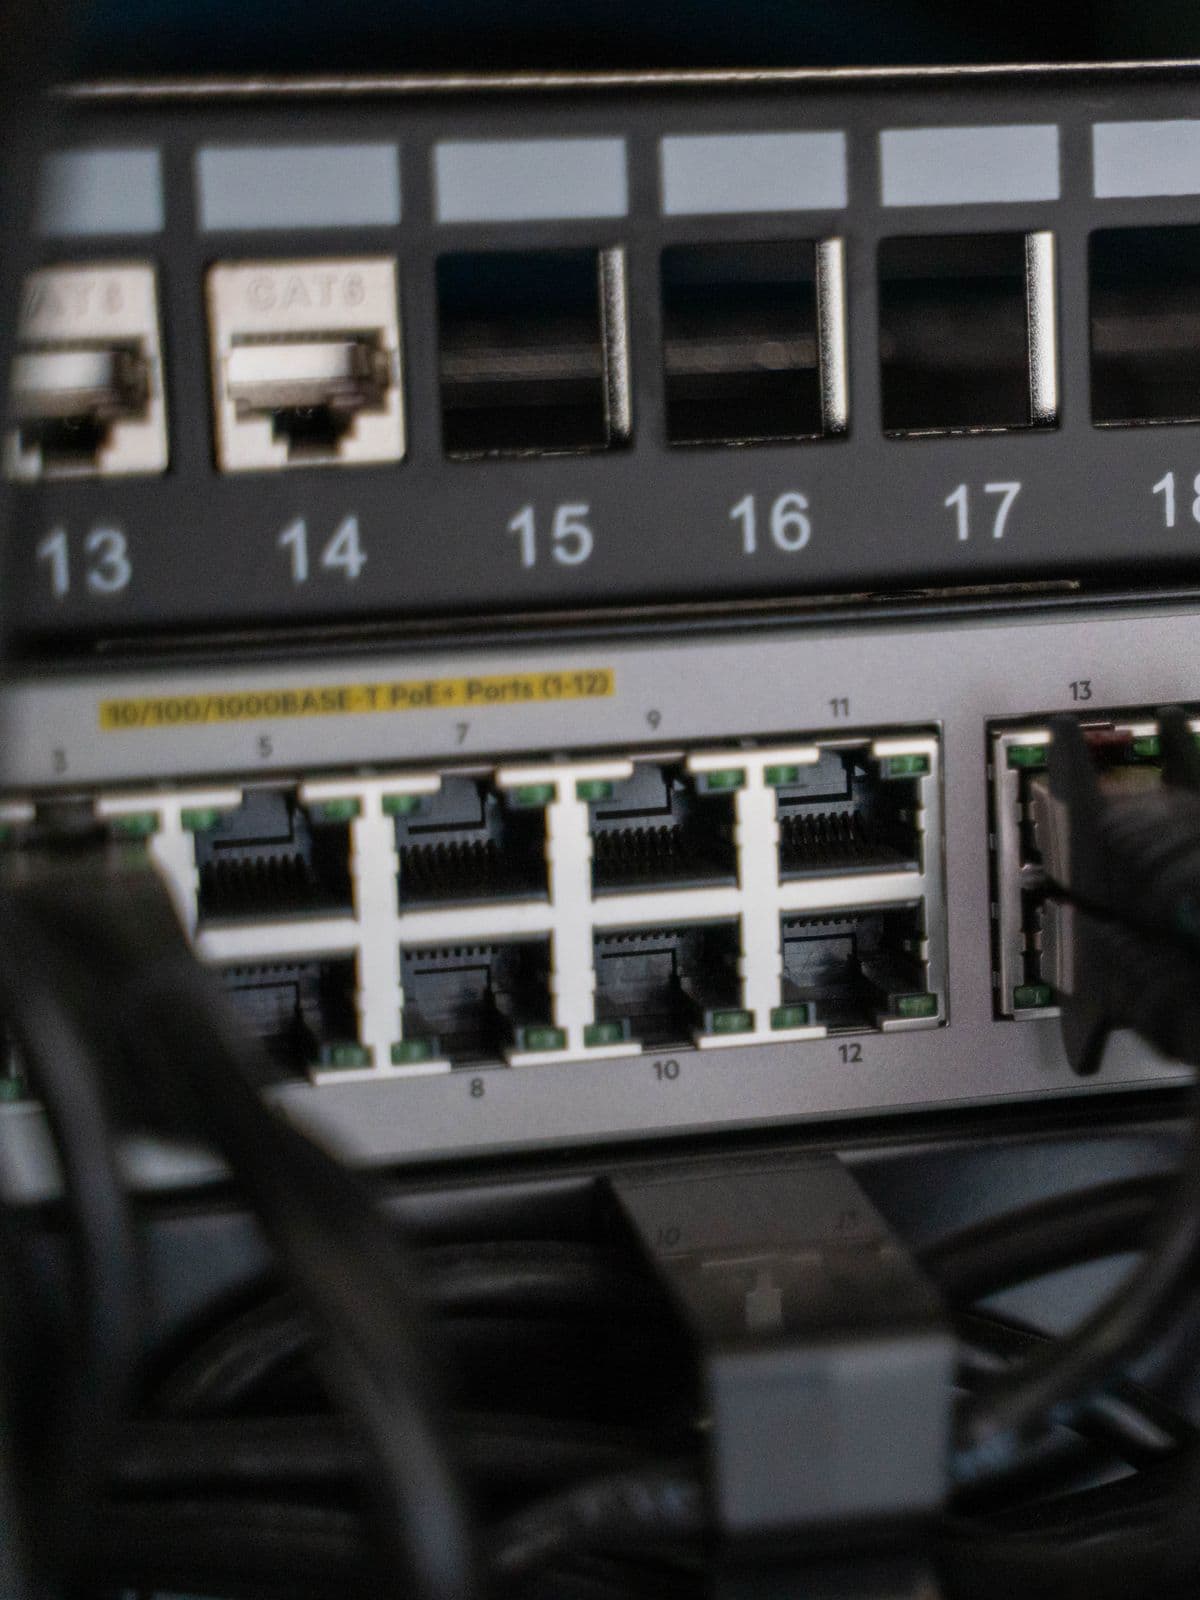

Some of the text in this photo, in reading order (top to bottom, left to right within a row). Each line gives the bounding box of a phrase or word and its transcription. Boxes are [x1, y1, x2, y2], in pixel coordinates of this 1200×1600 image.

[248, 272, 367, 313] CAT6
[729, 492, 812, 554] 16
[944, 481, 1022, 541] 17
[507, 503, 594, 568] 15
[37, 525, 132, 597] 13
[279, 515, 367, 583] 14
[109, 668, 610, 727] 10/100/1000BASE-T PoE+ Ports (1-12)
[1068, 679, 1092, 701] 13
[646, 709, 662, 730] 9
[829, 697, 850, 718] 11
[456, 721, 470, 745] 7
[257, 734, 273, 758] 5
[838, 1041, 863, 1064] 12
[653, 1059, 680, 1082] 10
[470, 1077, 485, 1099] 8
